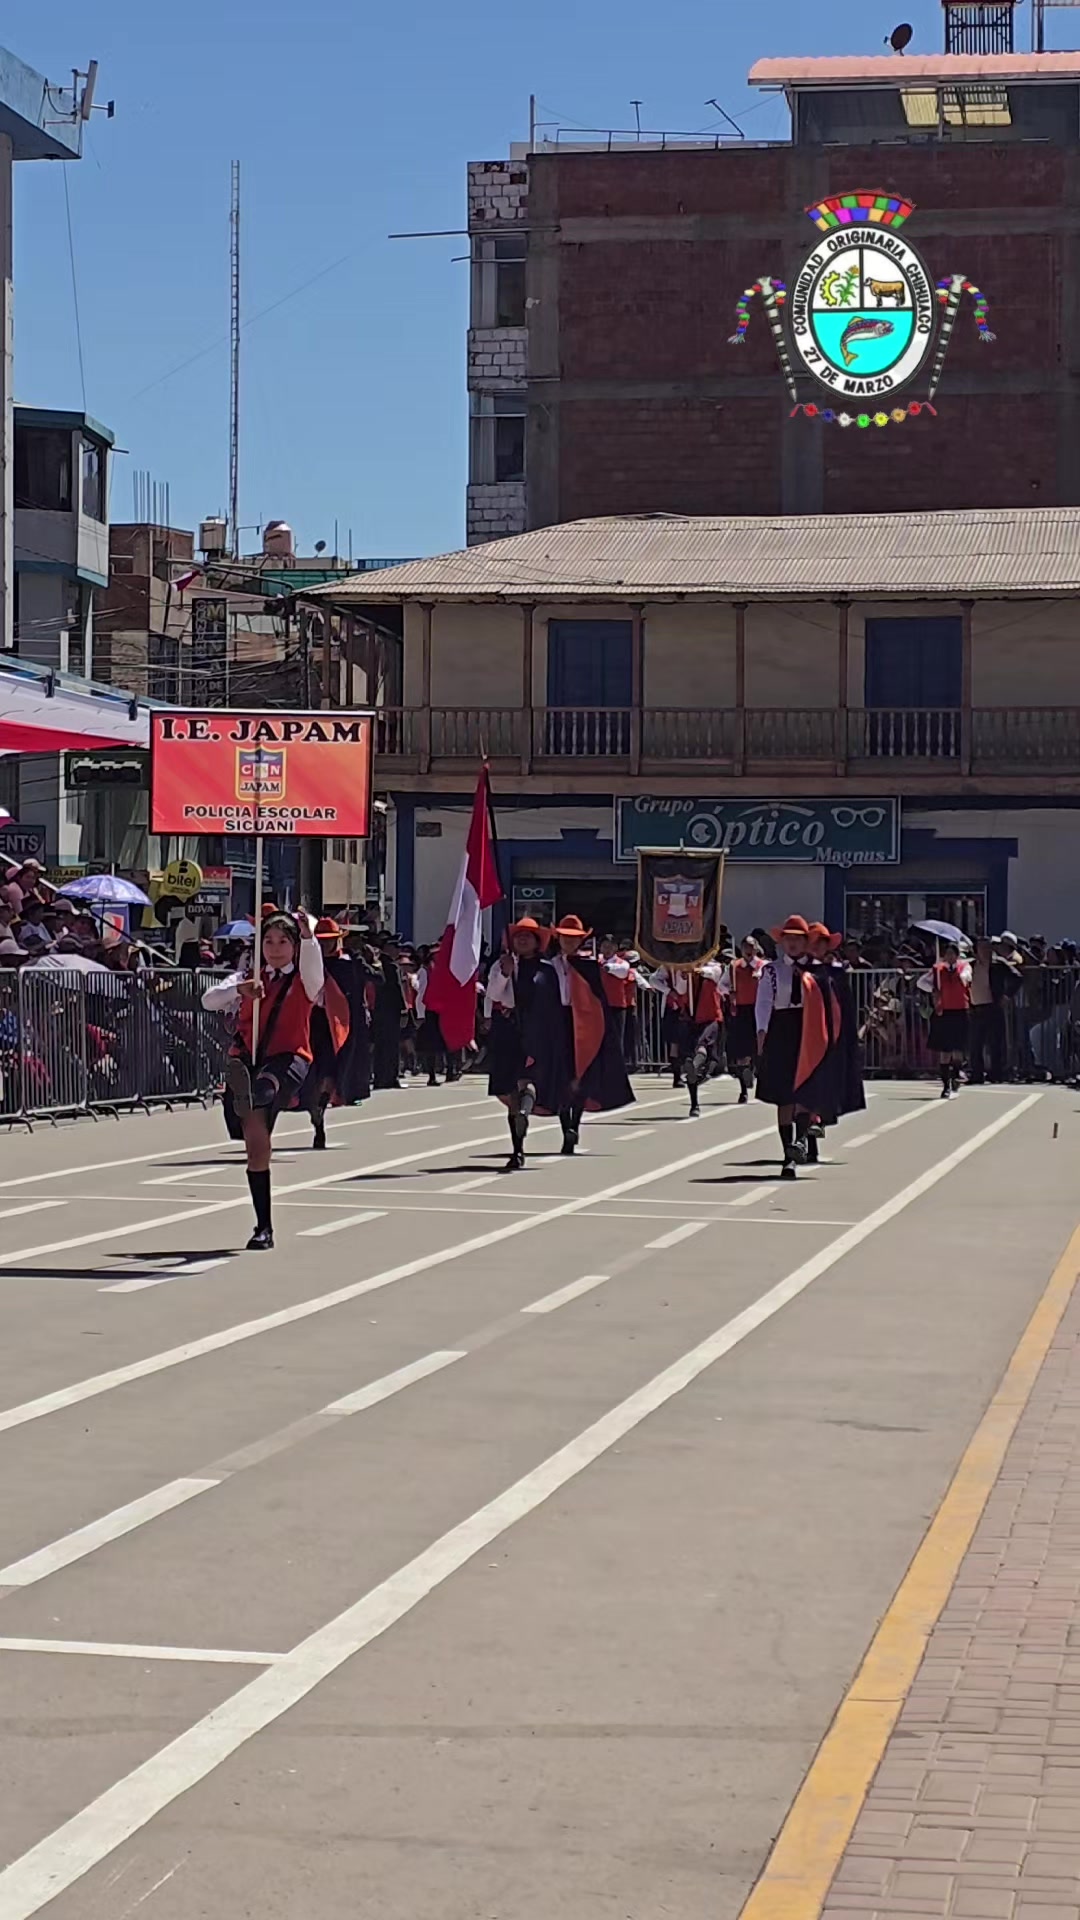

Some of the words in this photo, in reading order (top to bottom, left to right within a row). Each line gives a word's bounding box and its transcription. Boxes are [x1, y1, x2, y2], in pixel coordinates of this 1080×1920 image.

[160, 718, 221, 741] I.E.
[230, 720, 362, 743] JAPAM
[240, 780, 281, 792] JAPAM
[184, 805, 252, 818] POLICIA
[256, 807, 336, 819] ESCOLAR
[634, 796, 695, 817] Grupo
[225, 820, 294, 832] SICUANI
[814, 846, 886, 868] Magnus
[167, 873, 196, 888] bitel
